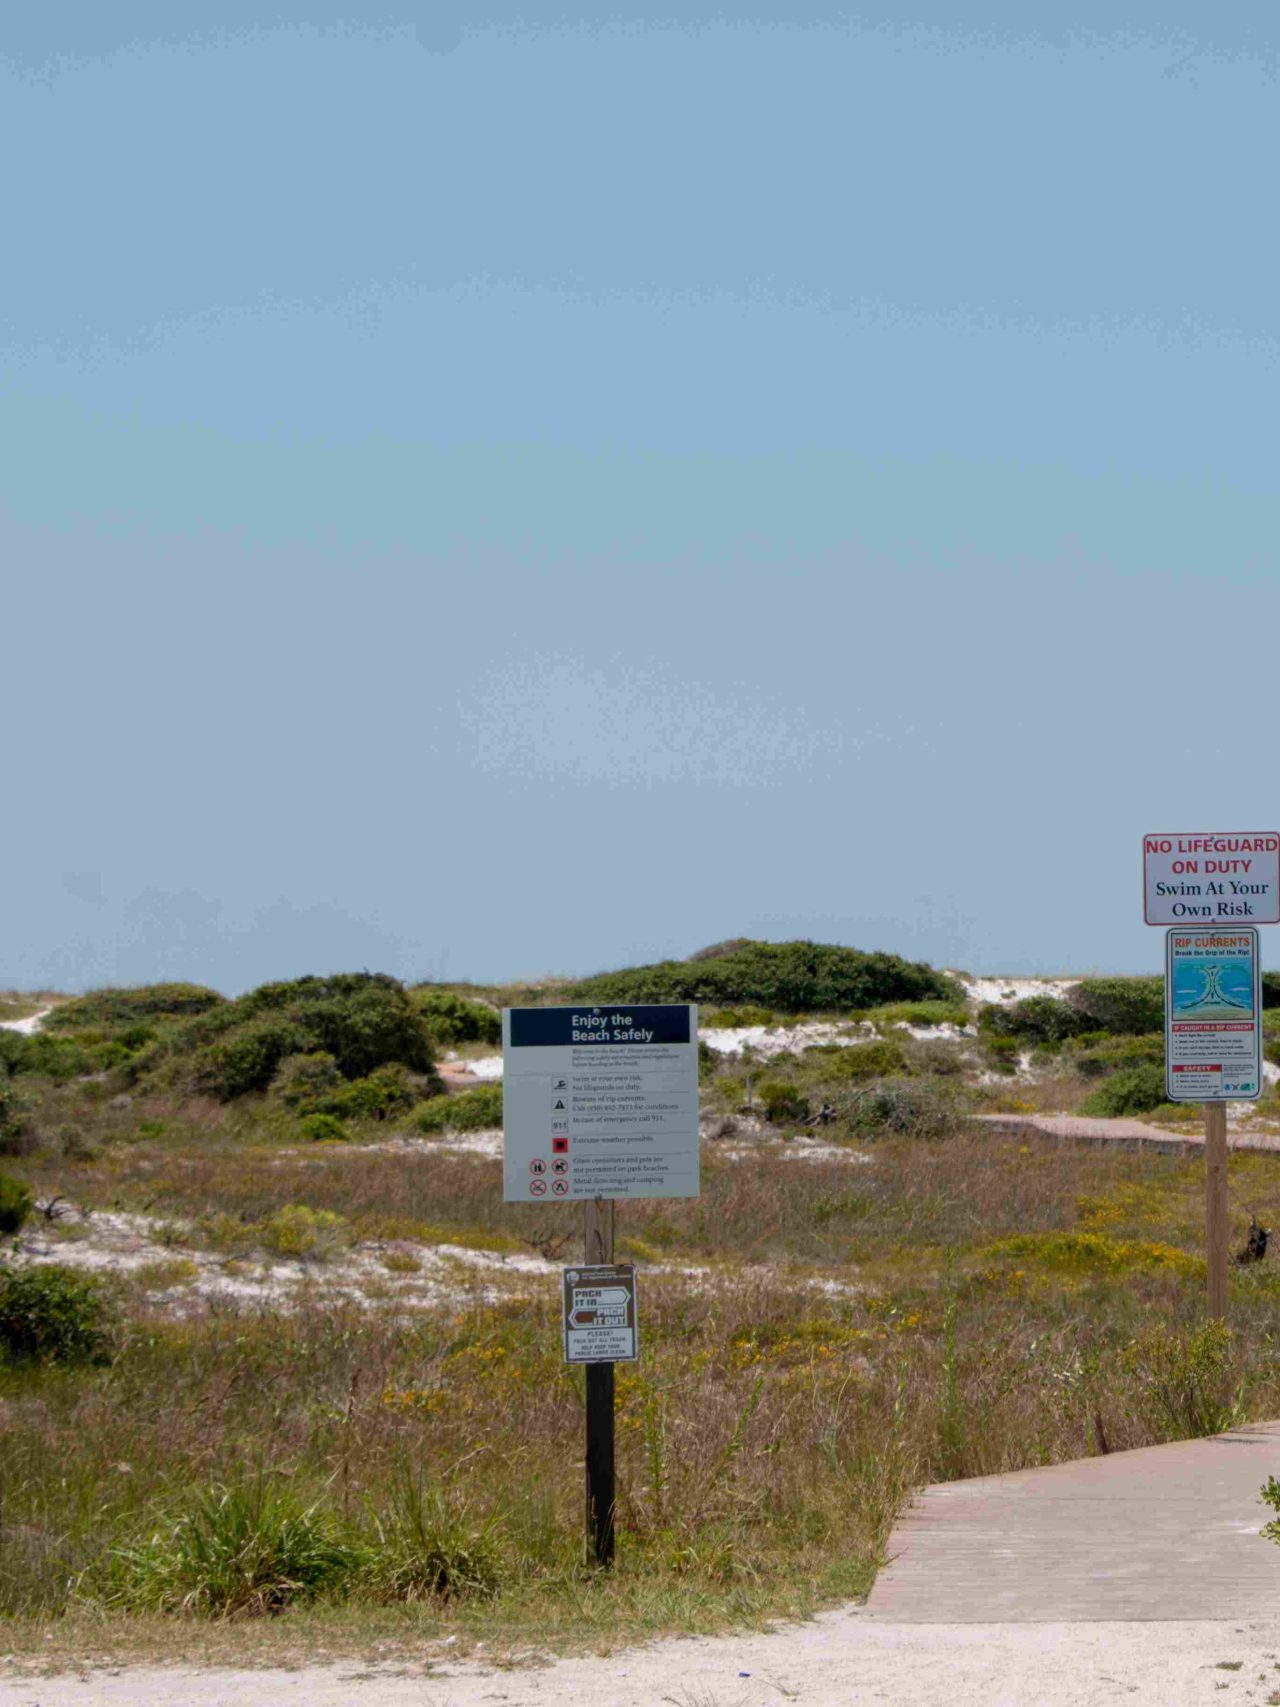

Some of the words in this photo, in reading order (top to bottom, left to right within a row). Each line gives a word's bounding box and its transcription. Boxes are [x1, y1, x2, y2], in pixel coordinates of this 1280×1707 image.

[1146, 840, 1172, 853] NO
[1178, 838, 1278, 853] LIFEGUARD
[1171, 861, 1199, 874] ON
[1204, 860, 1252, 874] DUTY
[1156, 881, 1201, 896] Swim
[1205, 881, 1225, 895] At
[1229, 880, 1269, 895] Your
[1171, 903, 1212, 916] Own
[1217, 902, 1254, 916] Risk
[1175, 938, 1191, 948] RIP
[1195, 937, 1250, 947] CURRENTS
[572, 1014, 608, 1028] Enjoy
[610, 1013, 633, 1026] the
[572, 1029, 610, 1041] Beach
[613, 1027, 654, 1043] Safely
[553, 1121, 568, 1129] 911
[575, 1290, 602, 1298] PACK
[597, 1308, 624, 1316] PACK
[593, 1317, 604, 1326] IT
[604, 1316, 625, 1325] OUT
